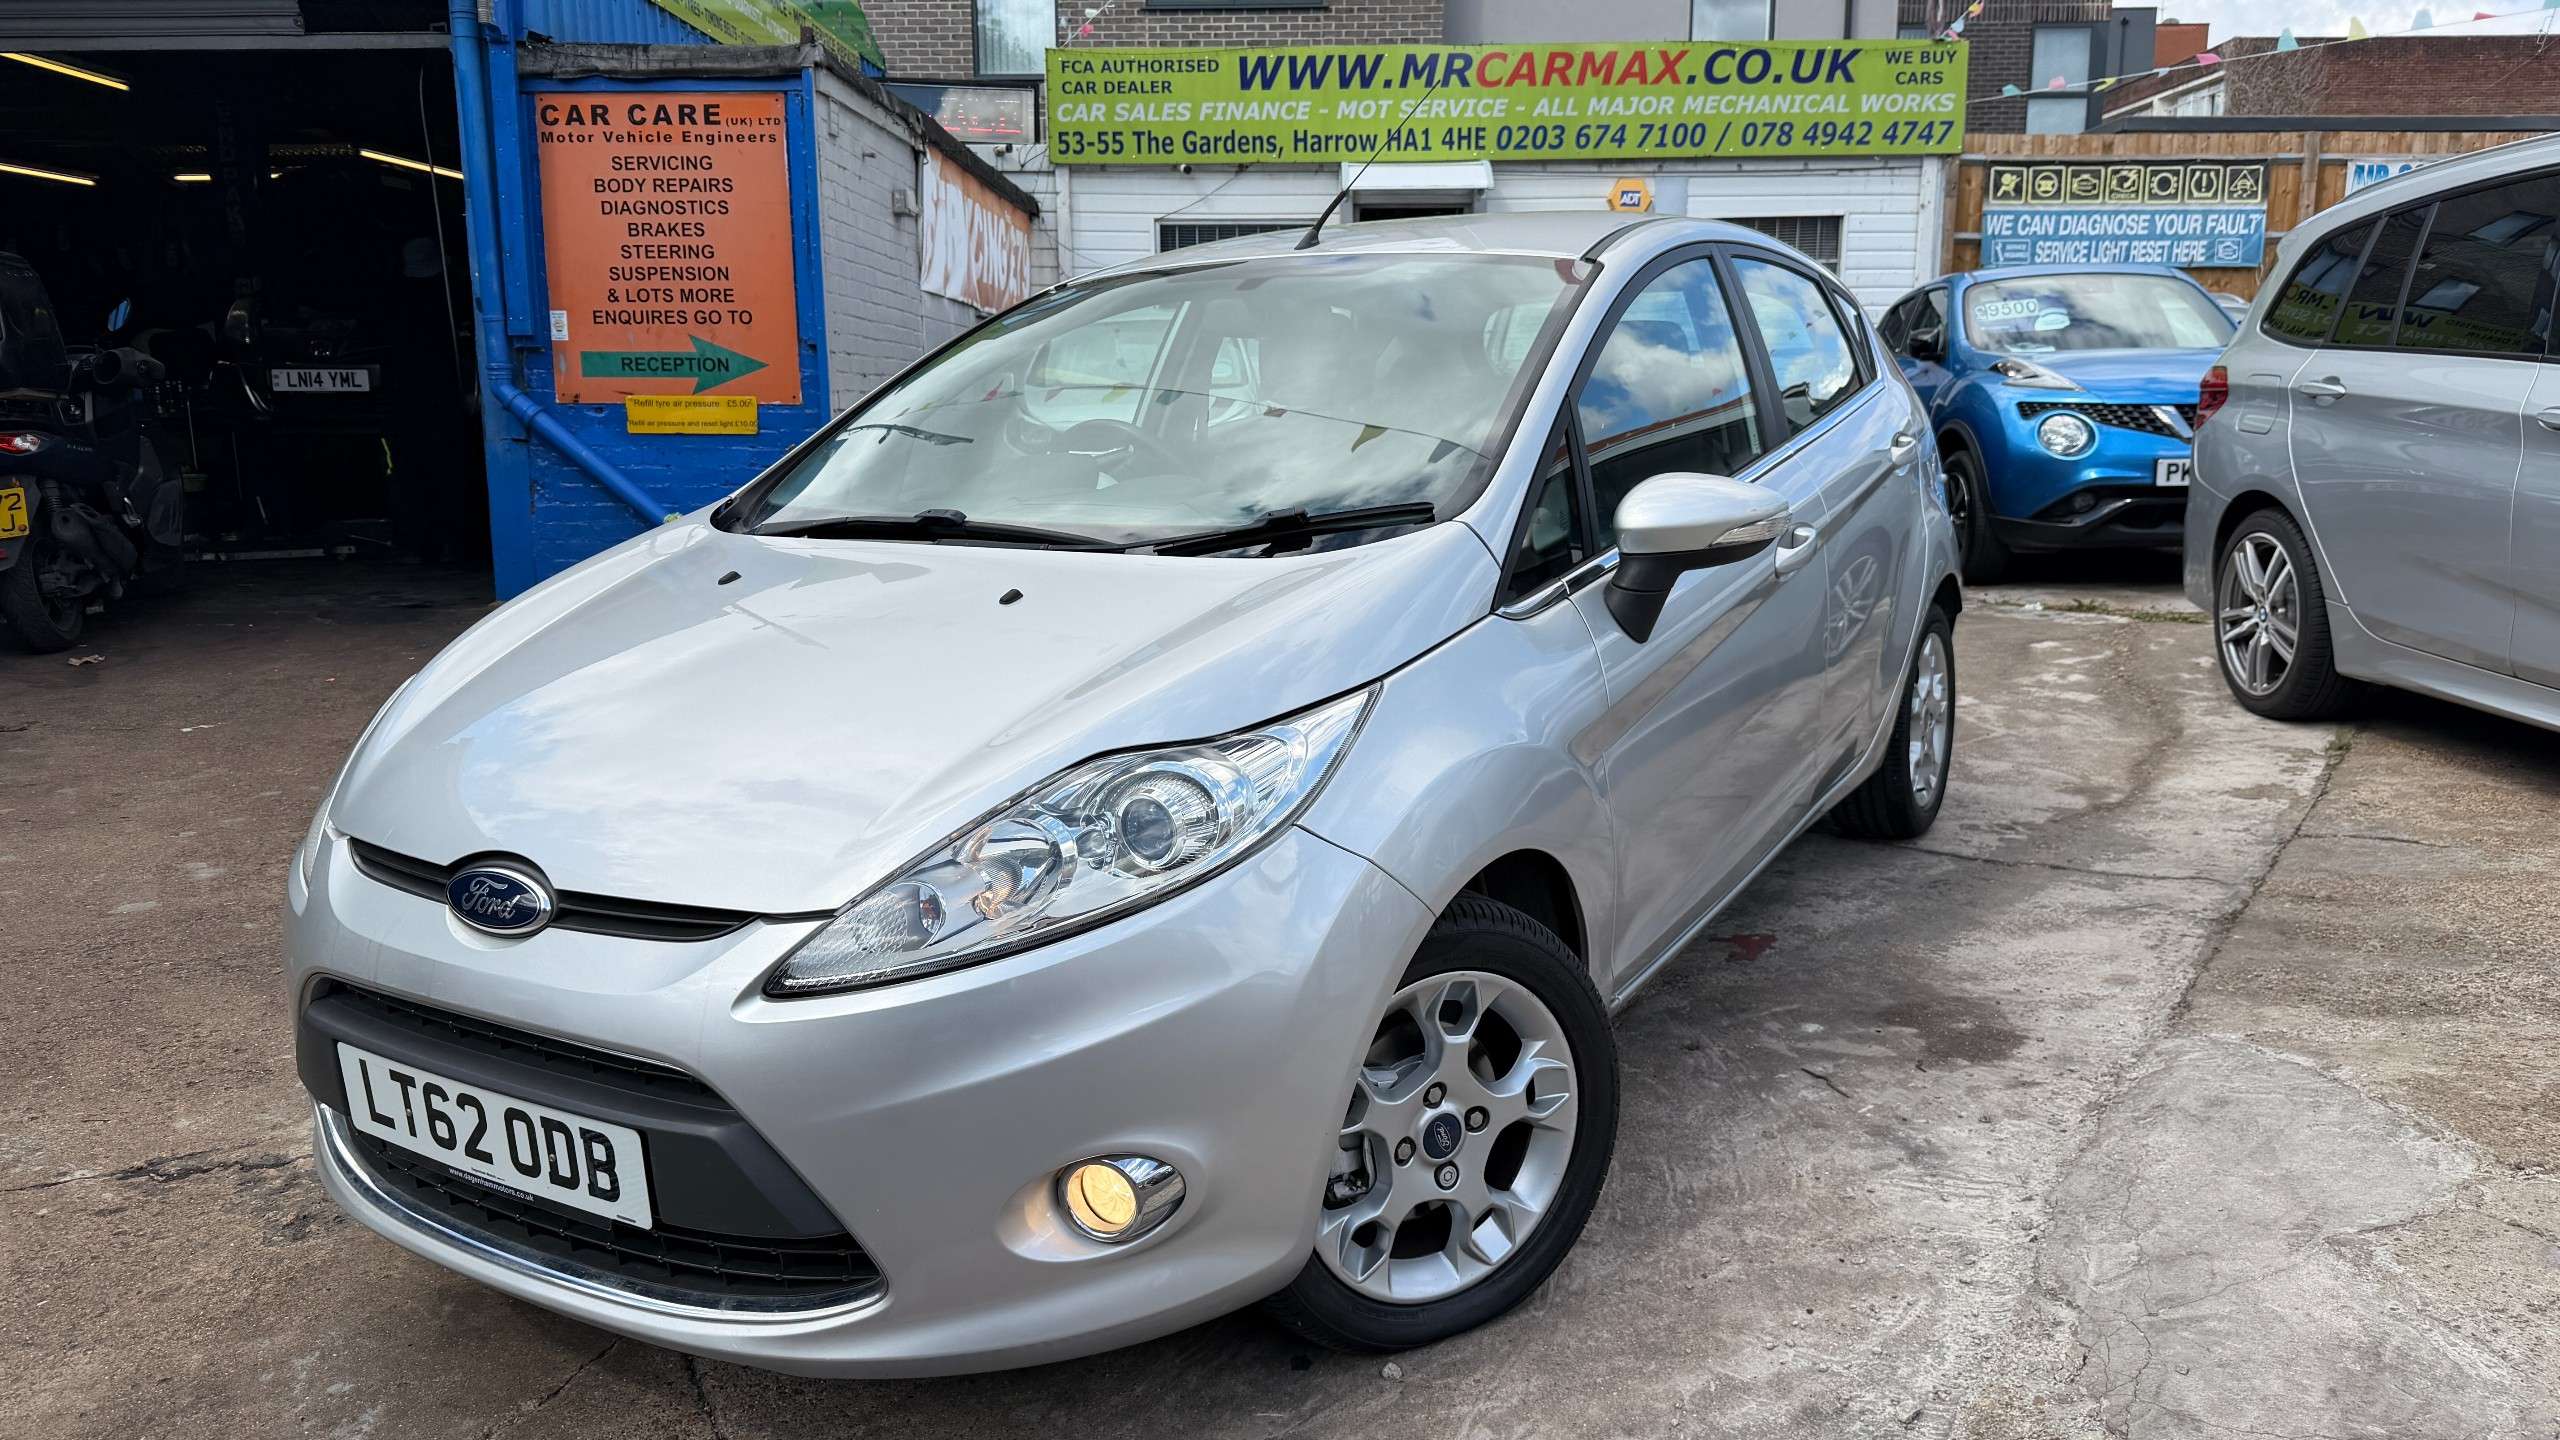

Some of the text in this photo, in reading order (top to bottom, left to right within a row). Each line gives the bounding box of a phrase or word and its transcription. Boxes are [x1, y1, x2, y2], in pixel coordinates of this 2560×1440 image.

[1885, 51, 1957, 64] WE BUY
[1061, 59, 1220, 74] FCA AUTHORISED
[1239, 48, 1864, 91] WWW.MRCARMAX.CO.UK
[1895, 71, 1944, 85] CARS
[1061, 80, 1173, 95] CAR DEALER
[540, 104, 781, 126] CAR CARE (UK) LTD
[1056, 102, 1106, 122] CAR
[1114, 102, 1192, 122] SALES
[1200, 101, 1312, 122] FINANCE
[1337, 100, 1393, 120] MOT
[1399, 98, 1509, 119] SERVICE
[1532, 97, 1578, 117] ALL
[1587, 96, 1675, 116] MAJOR
[1683, 93, 1851, 115] MECHANICAL
[1861, 93, 1957, 113] WORKS
[541, 131, 777, 145] Motor Vehicle Engineers
[1058, 131, 1125, 155] 53-55
[1132, 130, 1174, 154] The
[1182, 129, 1284, 158] Gardens,
[1294, 129, 1378, 153] Harrow
[1387, 127, 1432, 151] HA1
[1441, 127, 1486, 150] 4HE
[1496, 124, 1566, 150] 0203
[1575, 124, 1627, 149] 674
[1636, 123, 1706, 148] 7100
[1741, 121, 1794, 147] 078
[1802, 121, 1873, 146] 4942
[1881, 120, 1954, 145] 4747
[611, 156, 713, 171] SERVICING
[594, 178, 734, 193] BODY REPAIRS
[1620, 192, 1641, 205] ADT
[601, 200, 729, 215] DIAGNOSTICS
[628, 222, 705, 237] BRAKES
[1986, 213, 2262, 236] WE CAN DIAGNOSE YOUR FAULT
[620, 244, 715, 259] STEERING
[2034, 240, 2090, 263] SERVICE
[2090, 240, 2128, 263] LIGHT
[2129, 240, 2171, 263] RESET
[2172, 240, 2208, 262] HERE
[609, 266, 729, 281] SUSPENSION
[608, 288, 735, 303] & LOTS MORE
[593, 310, 753, 325] ENQUIRES GO TO
[621, 357, 730, 372] RECEPTION
[286, 371, 324, 387] LN14
[328, 371, 362, 387] YML
[633, 399, 654, 408] Refill
[655, 400, 671, 409] tyre
[673, 400, 682, 408] air
[685, 400, 720, 409] pressure
[0, 493, 22, 511] 2
[462, 877, 520, 919] Ford
[358, 1058, 621, 1203] LT62 ODB
[448, 1167, 535, 1201] www.dagenhammotors.co.uk
